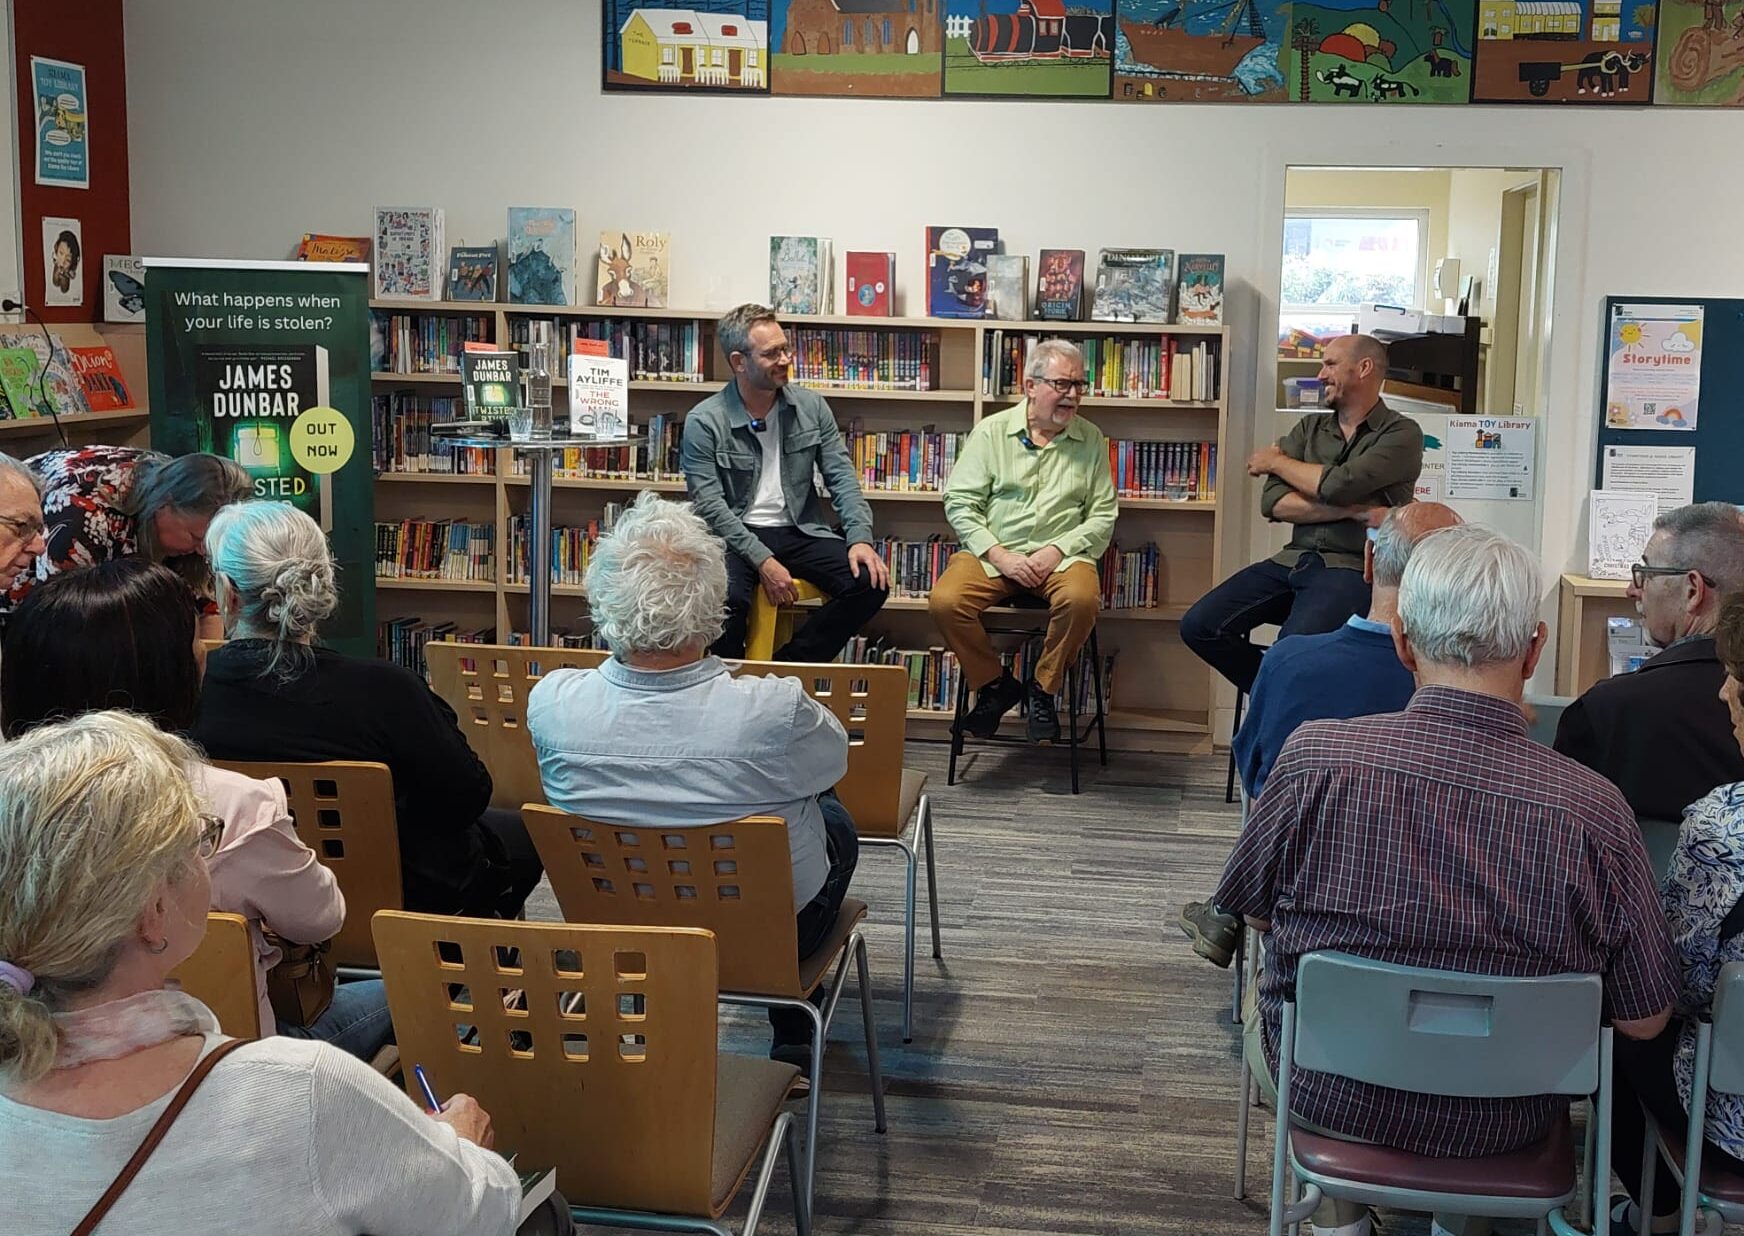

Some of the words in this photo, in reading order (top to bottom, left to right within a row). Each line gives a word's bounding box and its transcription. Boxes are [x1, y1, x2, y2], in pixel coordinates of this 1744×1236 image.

[636, 234, 666, 252] Roly
[175, 292, 219, 306] What
[223, 292, 294, 309] happens
[298, 294, 341, 308] when
[185, 316, 223, 332] your
[228, 315, 253, 329] life
[258, 316, 270, 329] is
[274, 316, 333, 330] stolen?
[475, 359, 508, 370] JAMES
[1623, 353, 1691, 366] Storytime
[219, 364, 293, 390] JAMES
[473, 370, 512, 382] DUNBAR
[589, 367, 610, 377] TIM
[576, 375, 624, 387] AYLIFFE
[590, 390, 610, 399] THE
[213, 392, 299, 417] DUNBAR
[580, 397, 620, 407] WRONG
[306, 423, 337, 436] OUT
[1449, 420, 1477, 428] Kiama
[1480, 420, 1497, 428] TOY
[1498, 421, 1531, 430] Library
[307, 445, 338, 457] NOW
